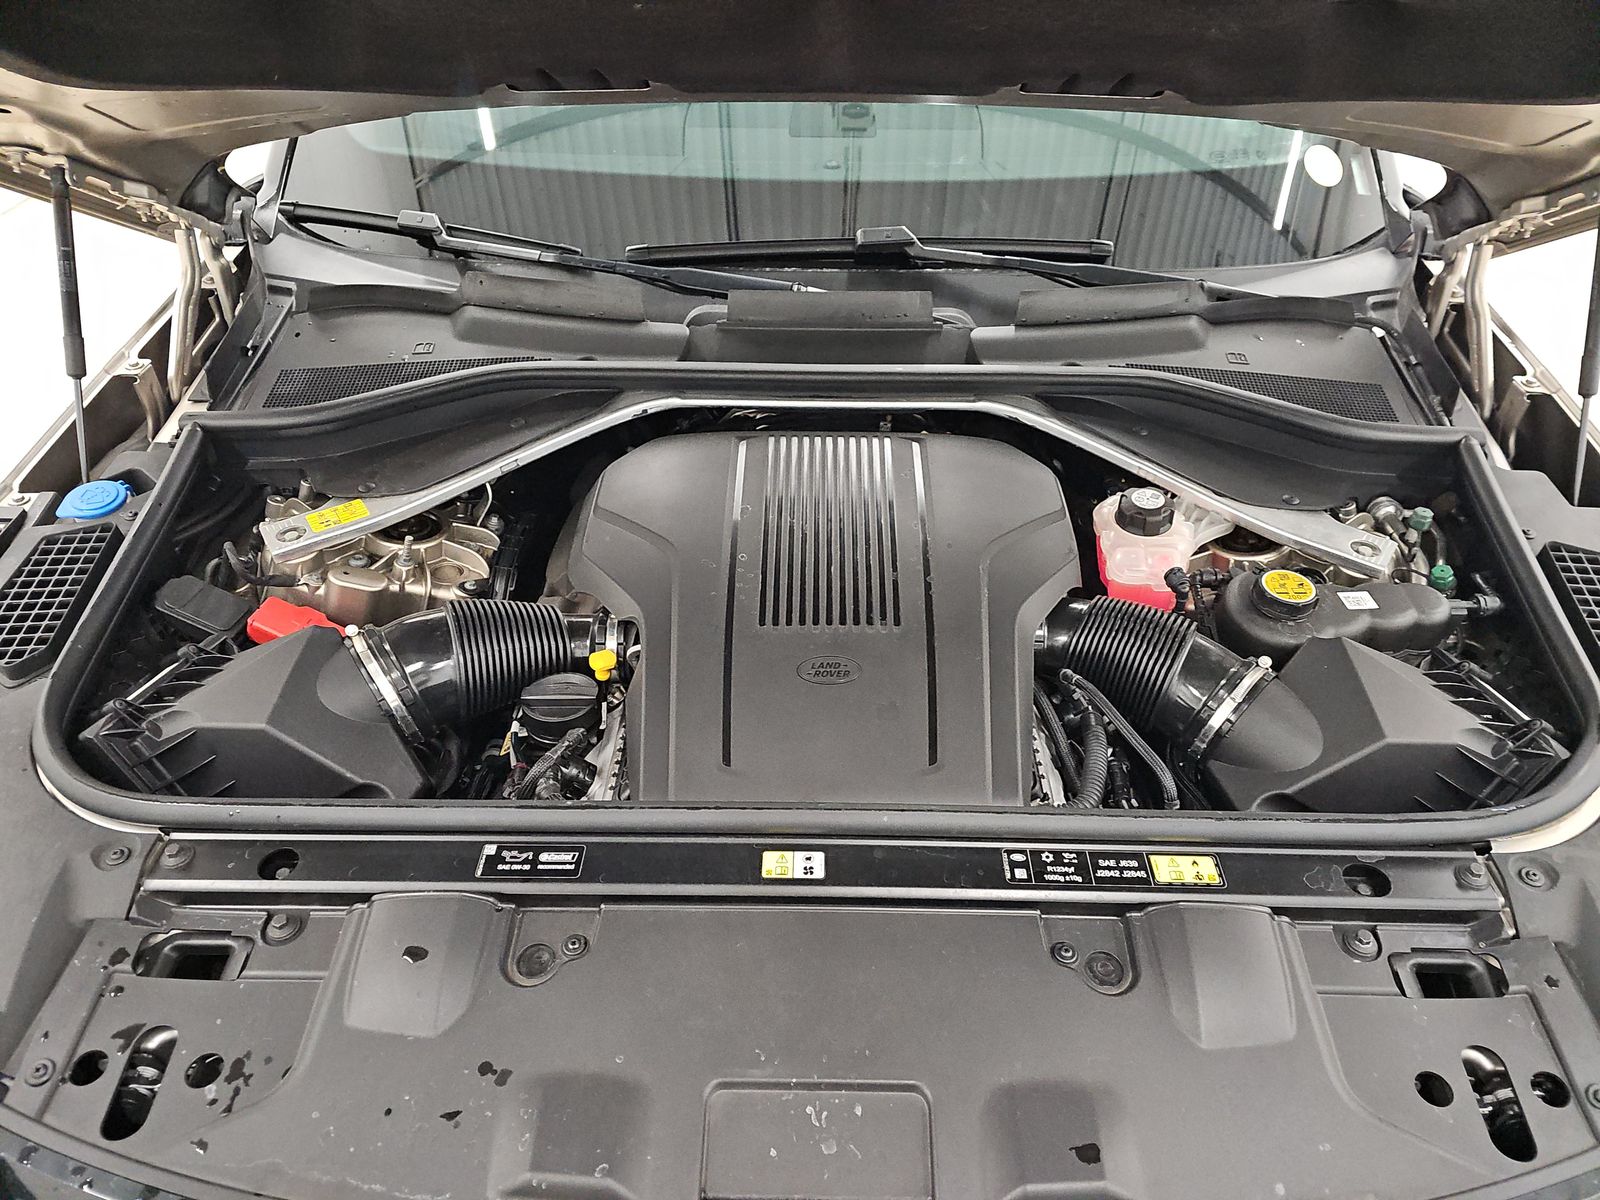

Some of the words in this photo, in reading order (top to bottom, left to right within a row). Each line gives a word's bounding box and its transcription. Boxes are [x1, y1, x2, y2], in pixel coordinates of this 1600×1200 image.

[1098, 859, 1117, 867] SAE
[1119, 860, 1139, 868] J639
[1046, 865, 1075, 874] R1234yf
[1095, 869, 1121, 877] J2842
[1121, 870, 1147, 878] J2845
[1043, 874, 1065, 882] 1000g
